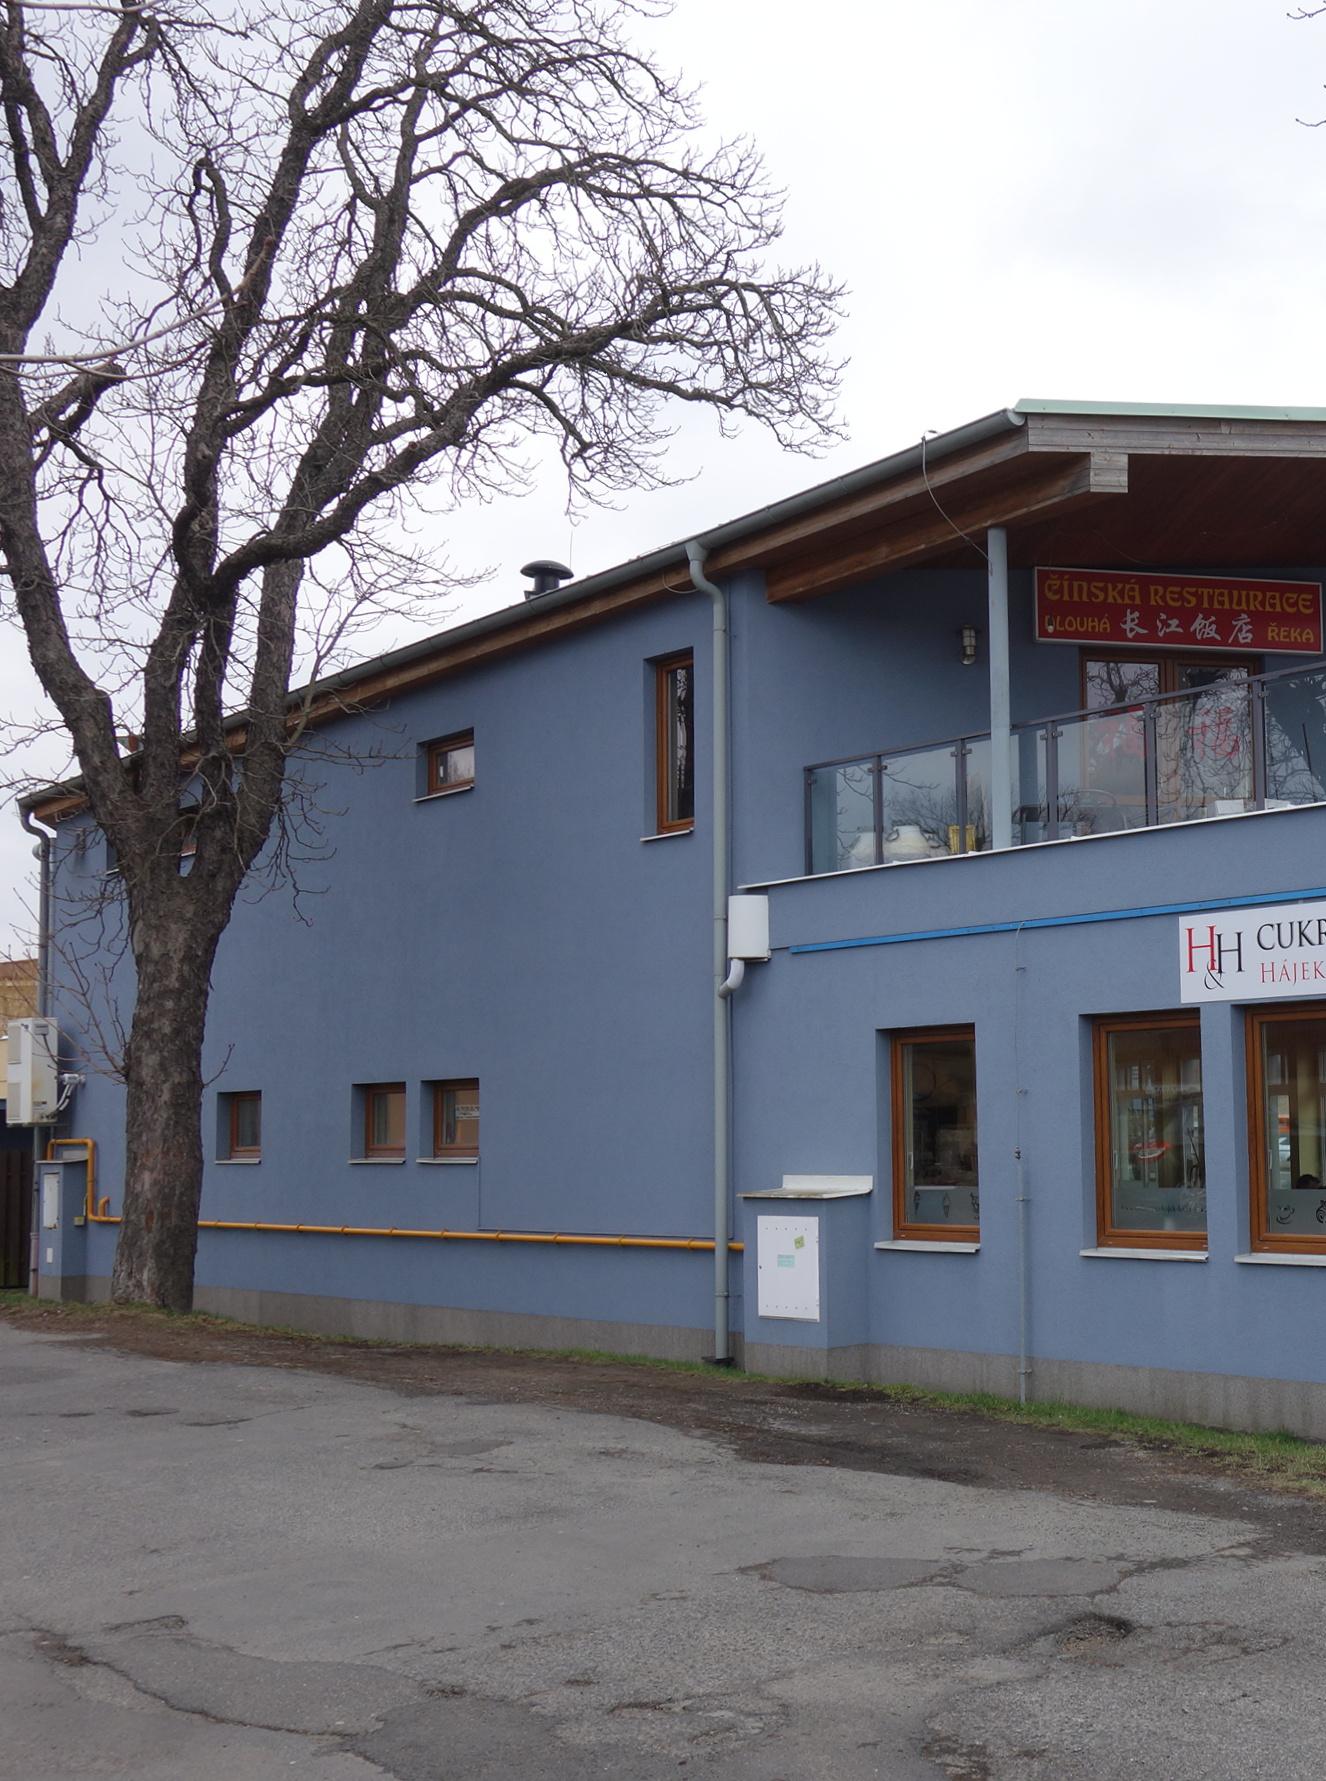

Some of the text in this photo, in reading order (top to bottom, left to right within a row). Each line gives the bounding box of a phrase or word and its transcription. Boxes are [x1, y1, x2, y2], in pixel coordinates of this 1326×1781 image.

[1044, 574, 1314, 615] ČÍNSKÁ RESTAURACE
[1120, 608, 1255, 645] 长江饭店
[1268, 622, 1314, 643] ŘEKA
